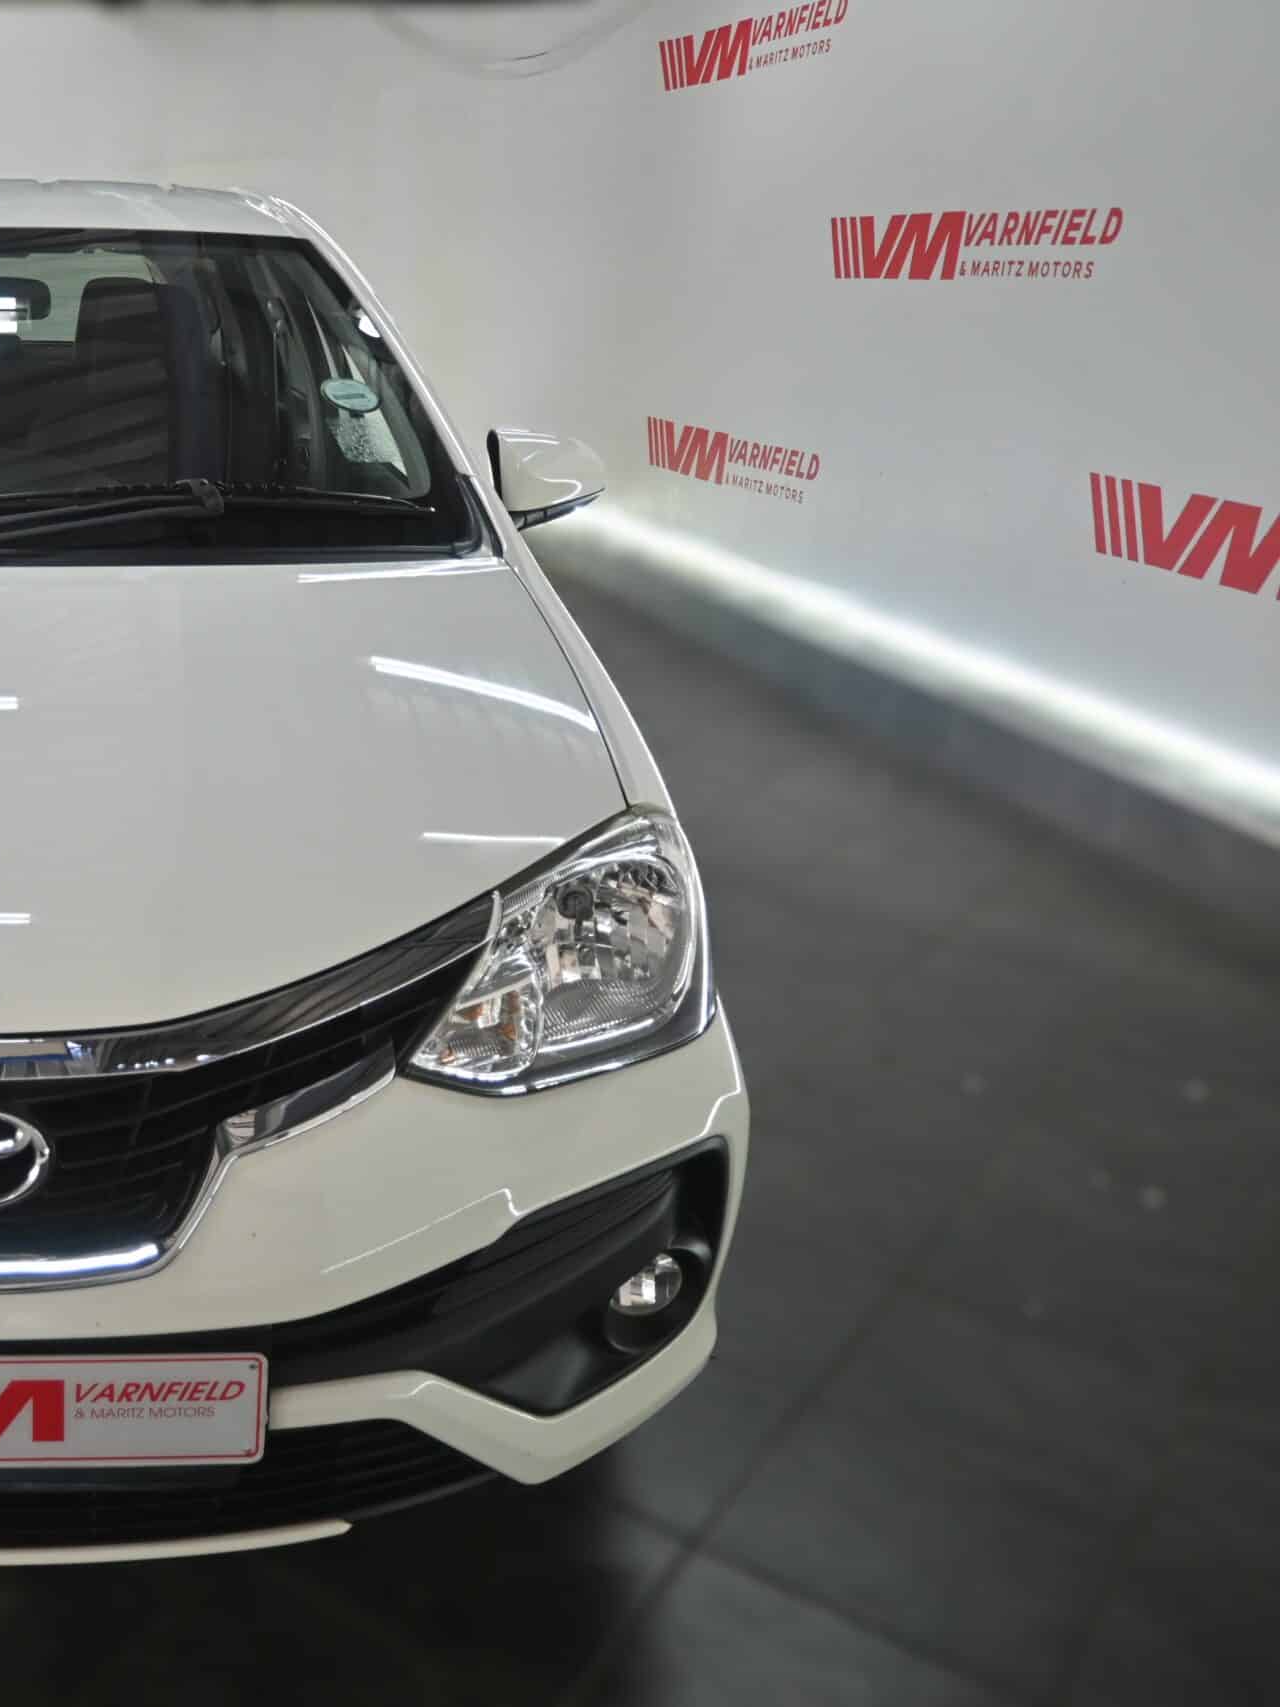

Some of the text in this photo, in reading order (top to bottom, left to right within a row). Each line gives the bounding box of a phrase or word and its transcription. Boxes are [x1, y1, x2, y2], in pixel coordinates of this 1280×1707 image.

[752, 0, 849, 46] VARNFIELD
[683, 18, 753, 86] VM
[755, 48, 789, 69] MARITZ
[791, 38, 832, 59] MOTORS
[859, 210, 967, 281] VM
[963, 207, 1124, 247] VARNFIELD
[959, 260, 1095, 279] & MARITZ MOTORS
[665, 420, 729, 486] VM
[728, 437, 821, 481] VARNFIELD
[766, 482, 804, 504] MOTORS
[74, 1380, 247, 1404] VARNFIELD
[73, 1406, 216, 1419] & MARITZ MOTORS
